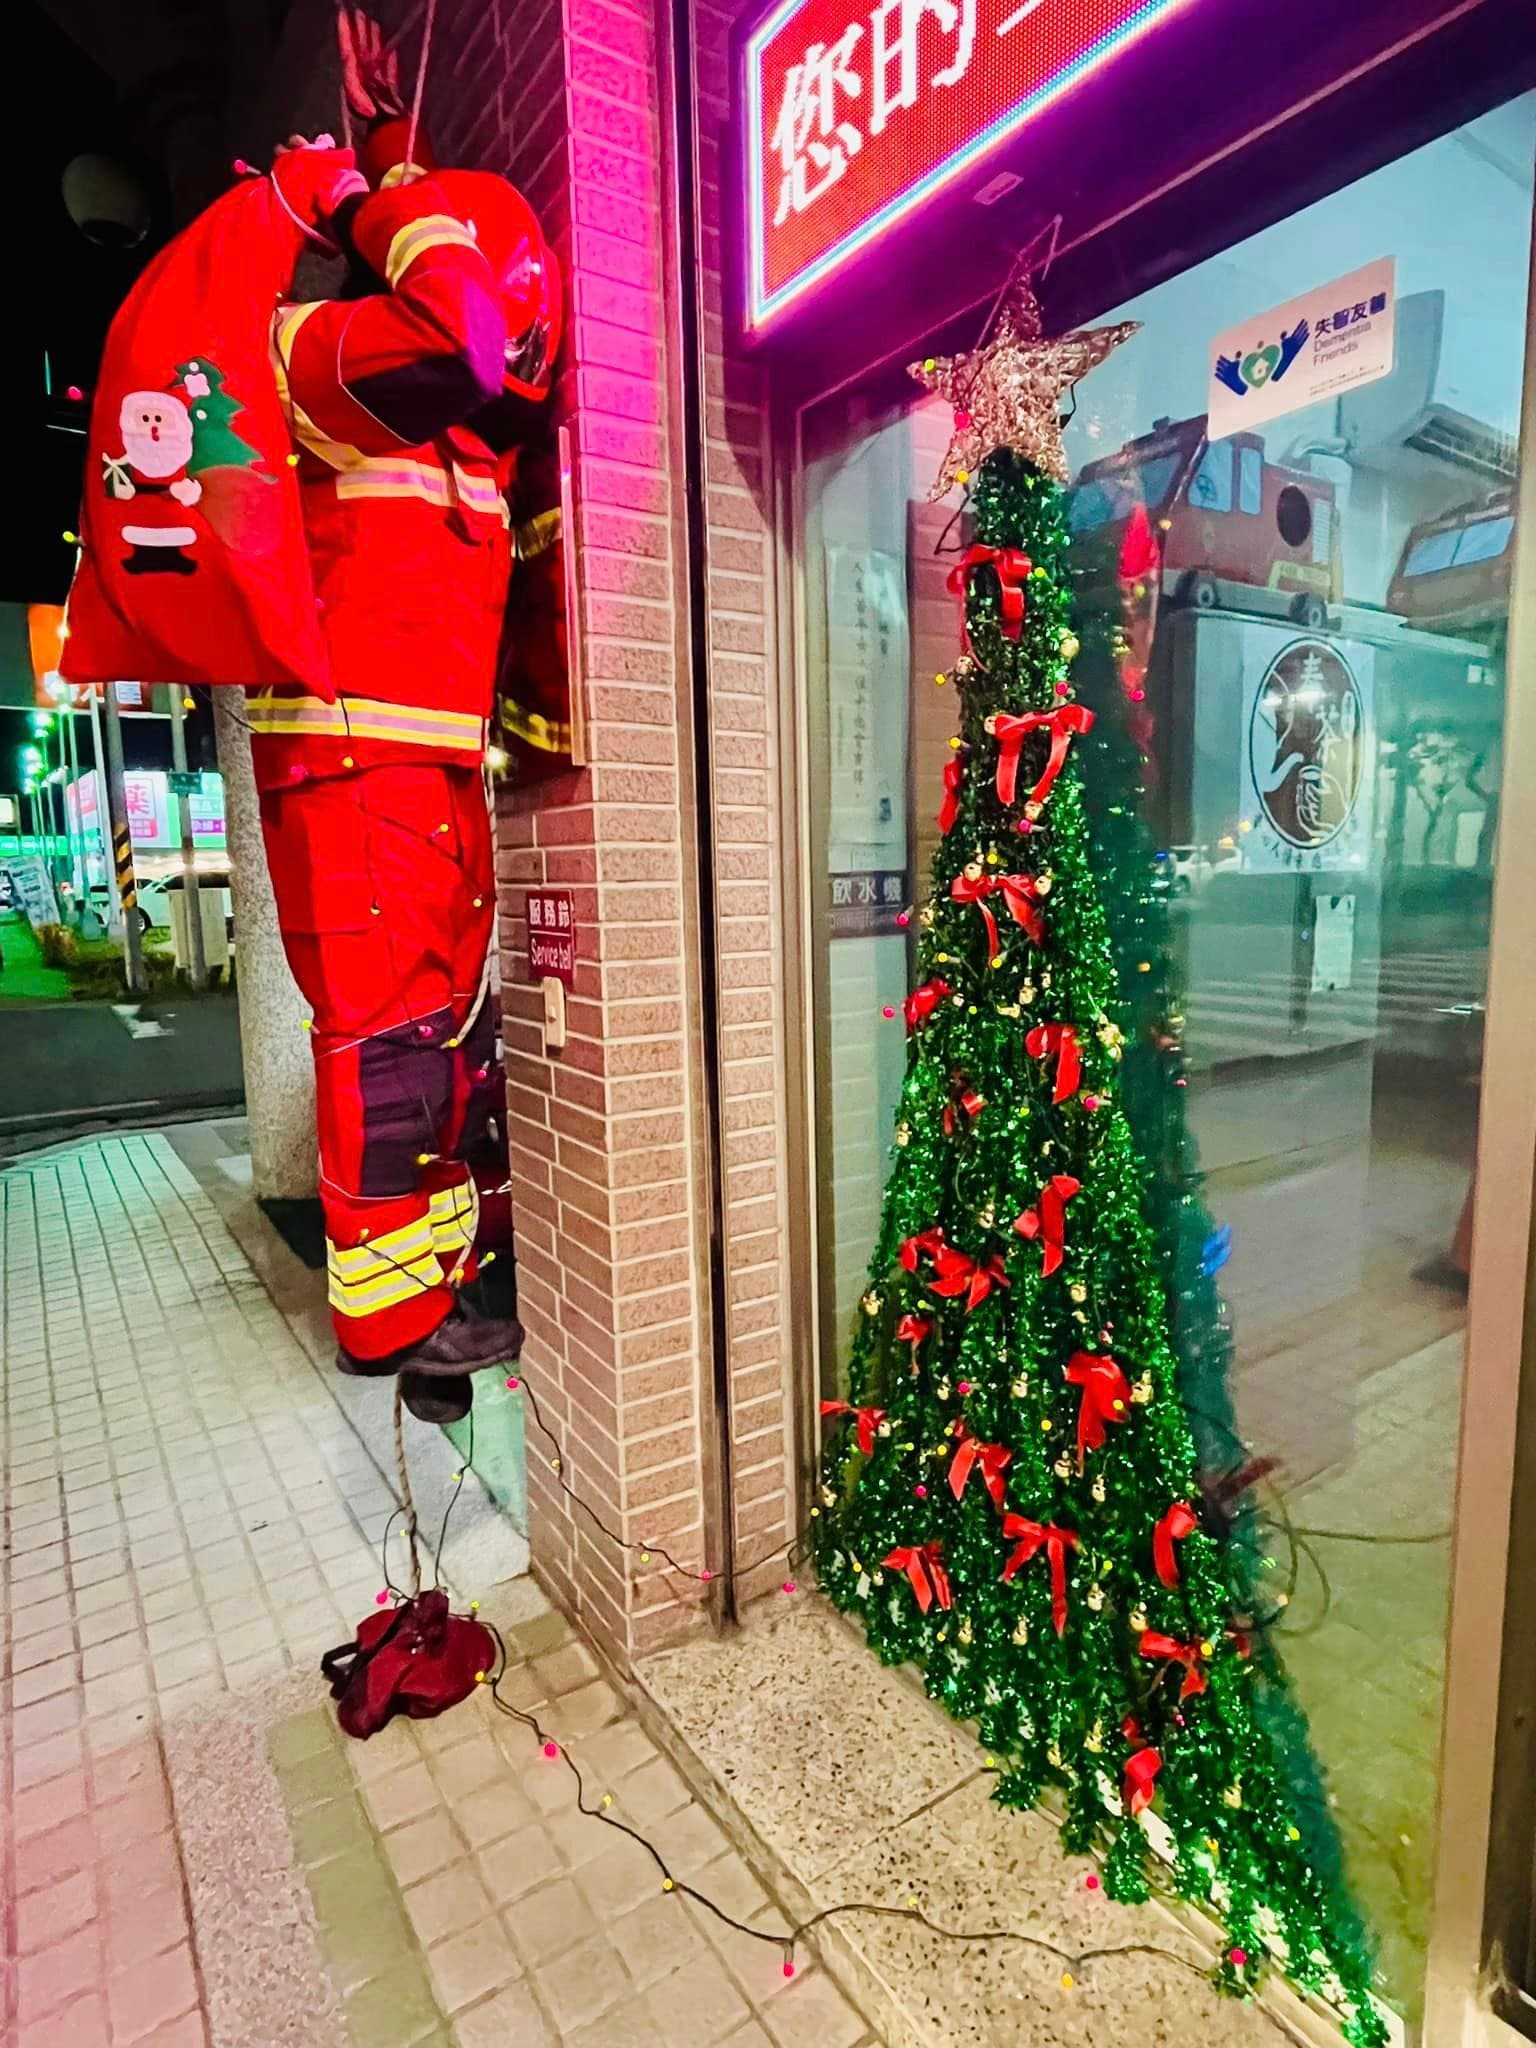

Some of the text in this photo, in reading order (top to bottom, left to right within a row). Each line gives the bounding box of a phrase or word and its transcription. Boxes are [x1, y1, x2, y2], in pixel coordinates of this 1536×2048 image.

[1314, 321, 1371, 353] Dementia
[1313, 341, 1358, 367] Friends
[531, 938, 558, 968] Service
